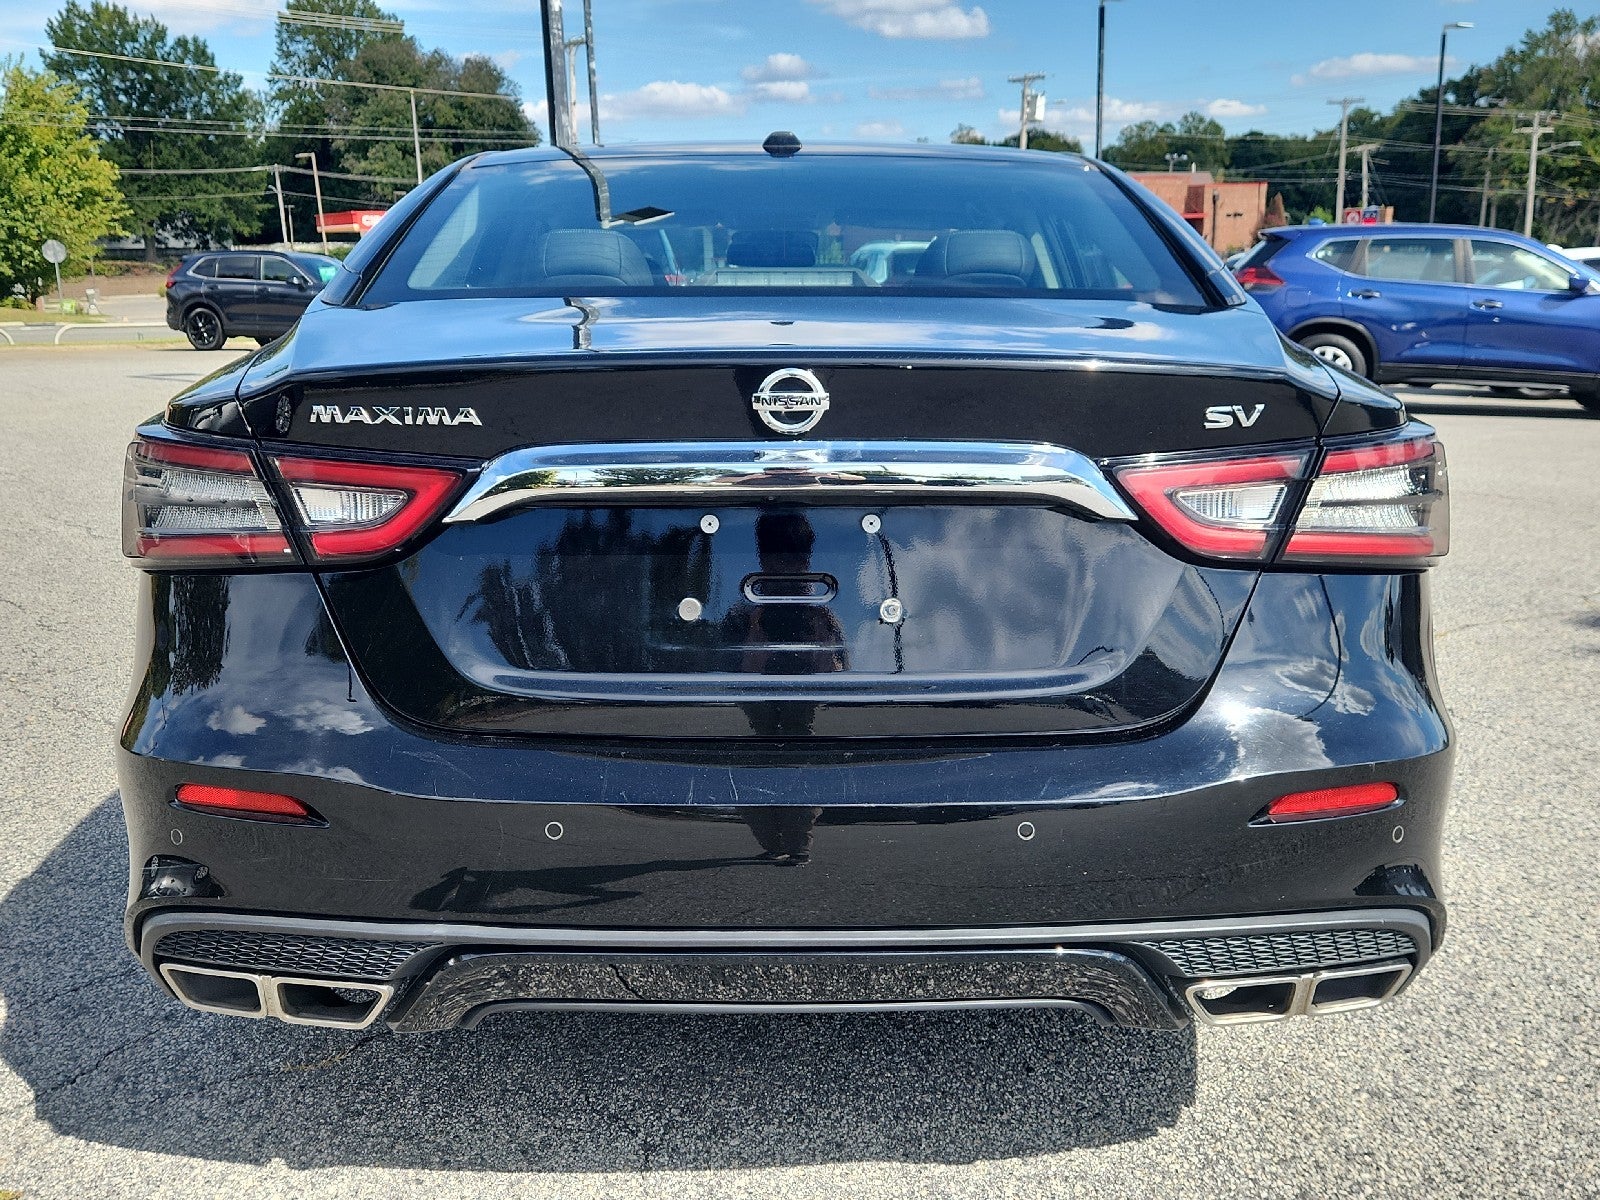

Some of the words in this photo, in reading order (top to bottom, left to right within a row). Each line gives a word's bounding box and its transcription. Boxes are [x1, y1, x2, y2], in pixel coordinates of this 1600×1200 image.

[761, 396, 821, 406] NISSAN
[309, 405, 483, 426] MAXIMA
[1203, 403, 1266, 429] SV
